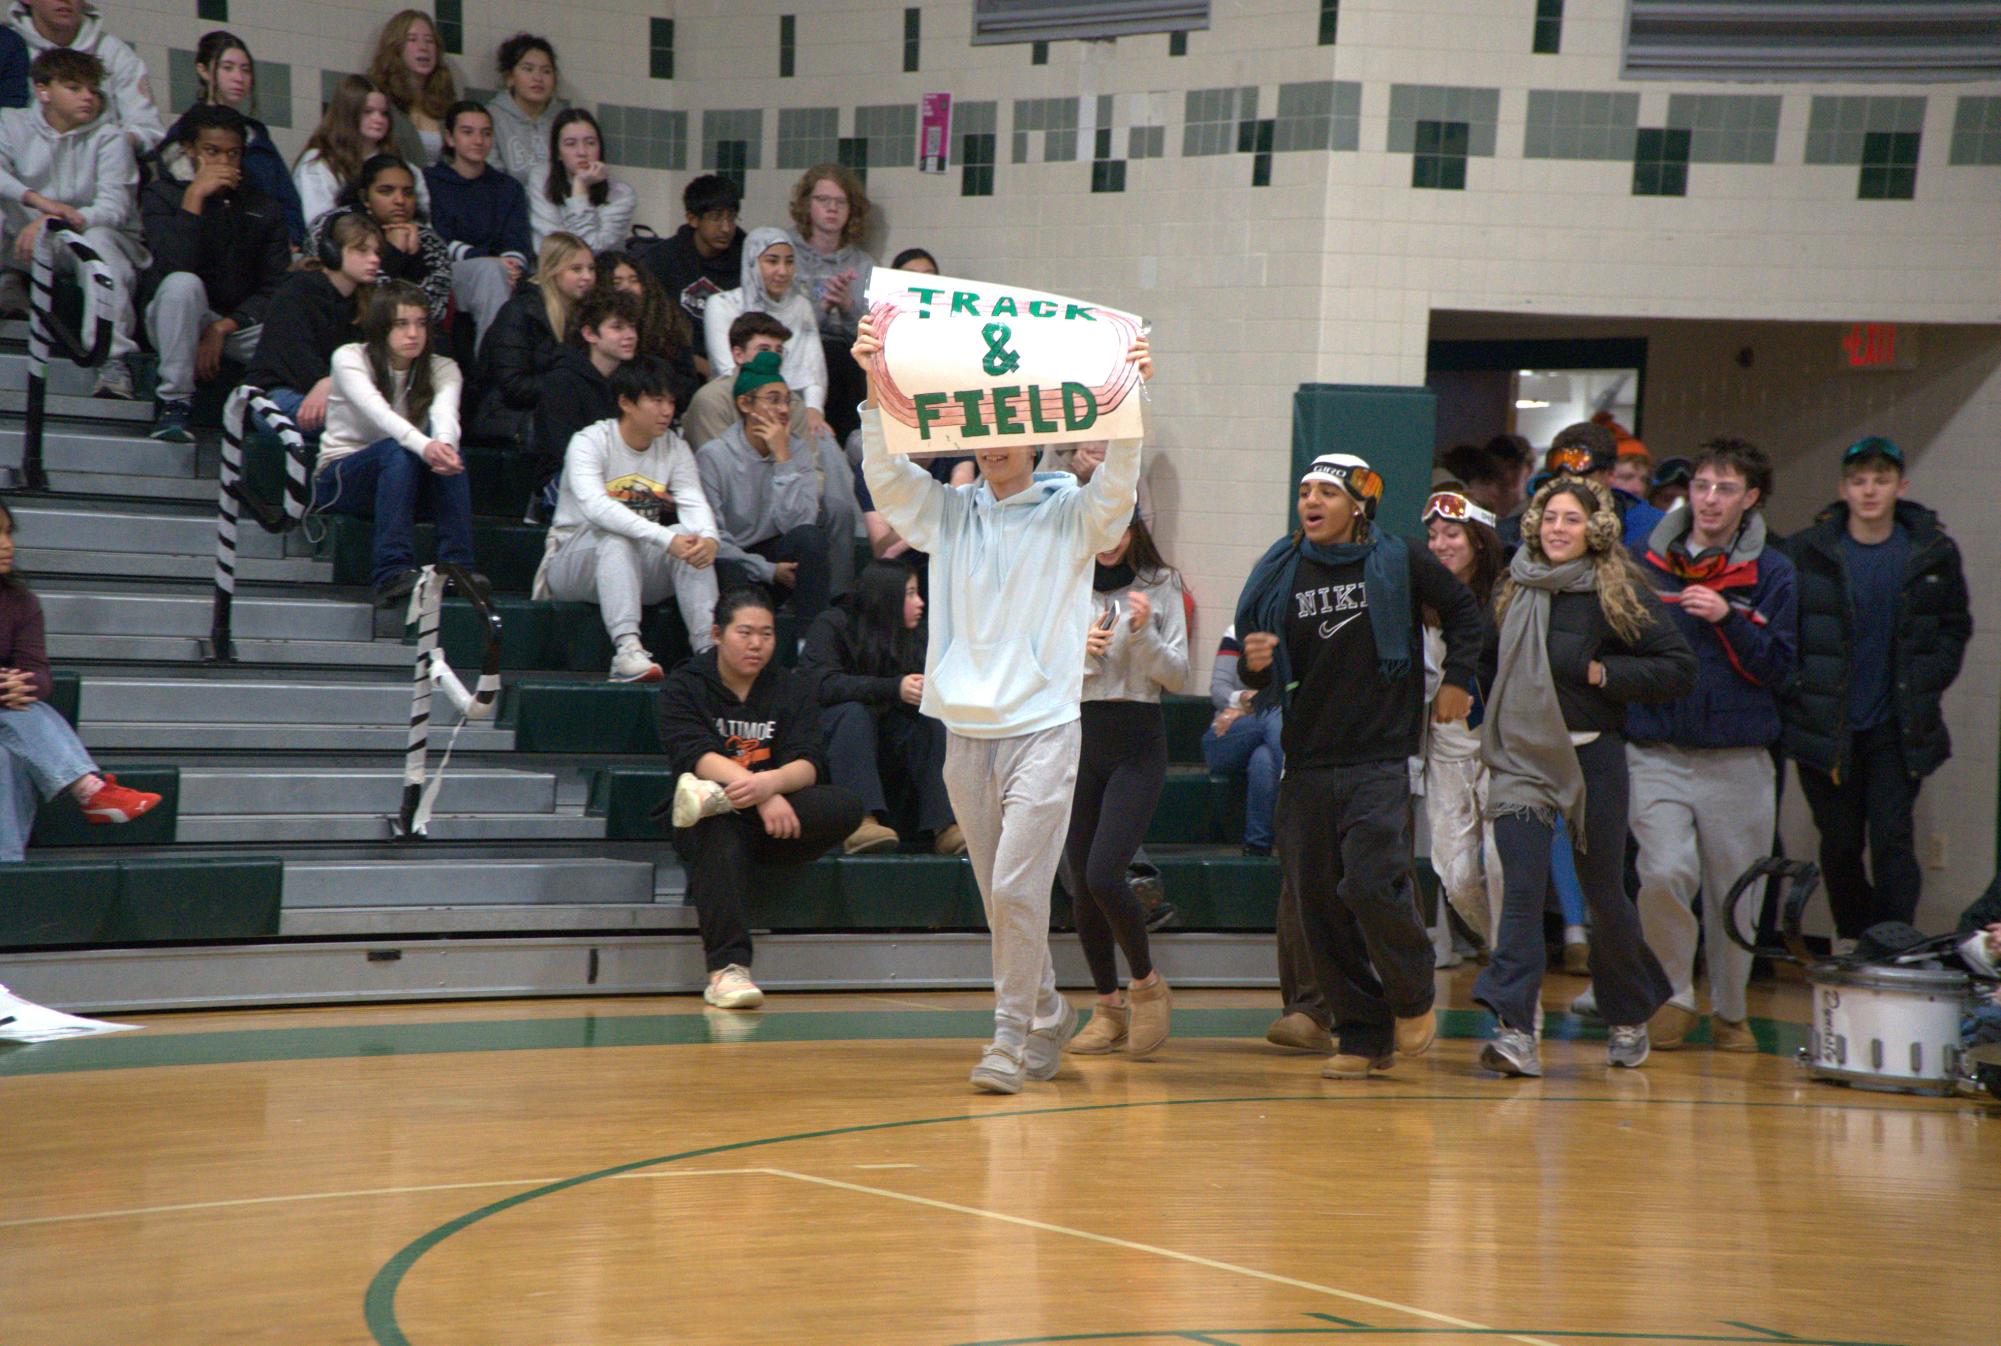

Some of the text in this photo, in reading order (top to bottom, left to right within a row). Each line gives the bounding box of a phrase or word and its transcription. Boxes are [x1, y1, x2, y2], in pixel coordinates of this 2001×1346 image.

[907, 286, 1097, 321] TRACK
[981, 321, 1020, 376] &
[913, 381, 1098, 440] FIELD
[1313, 464, 1347, 478] GIRO
